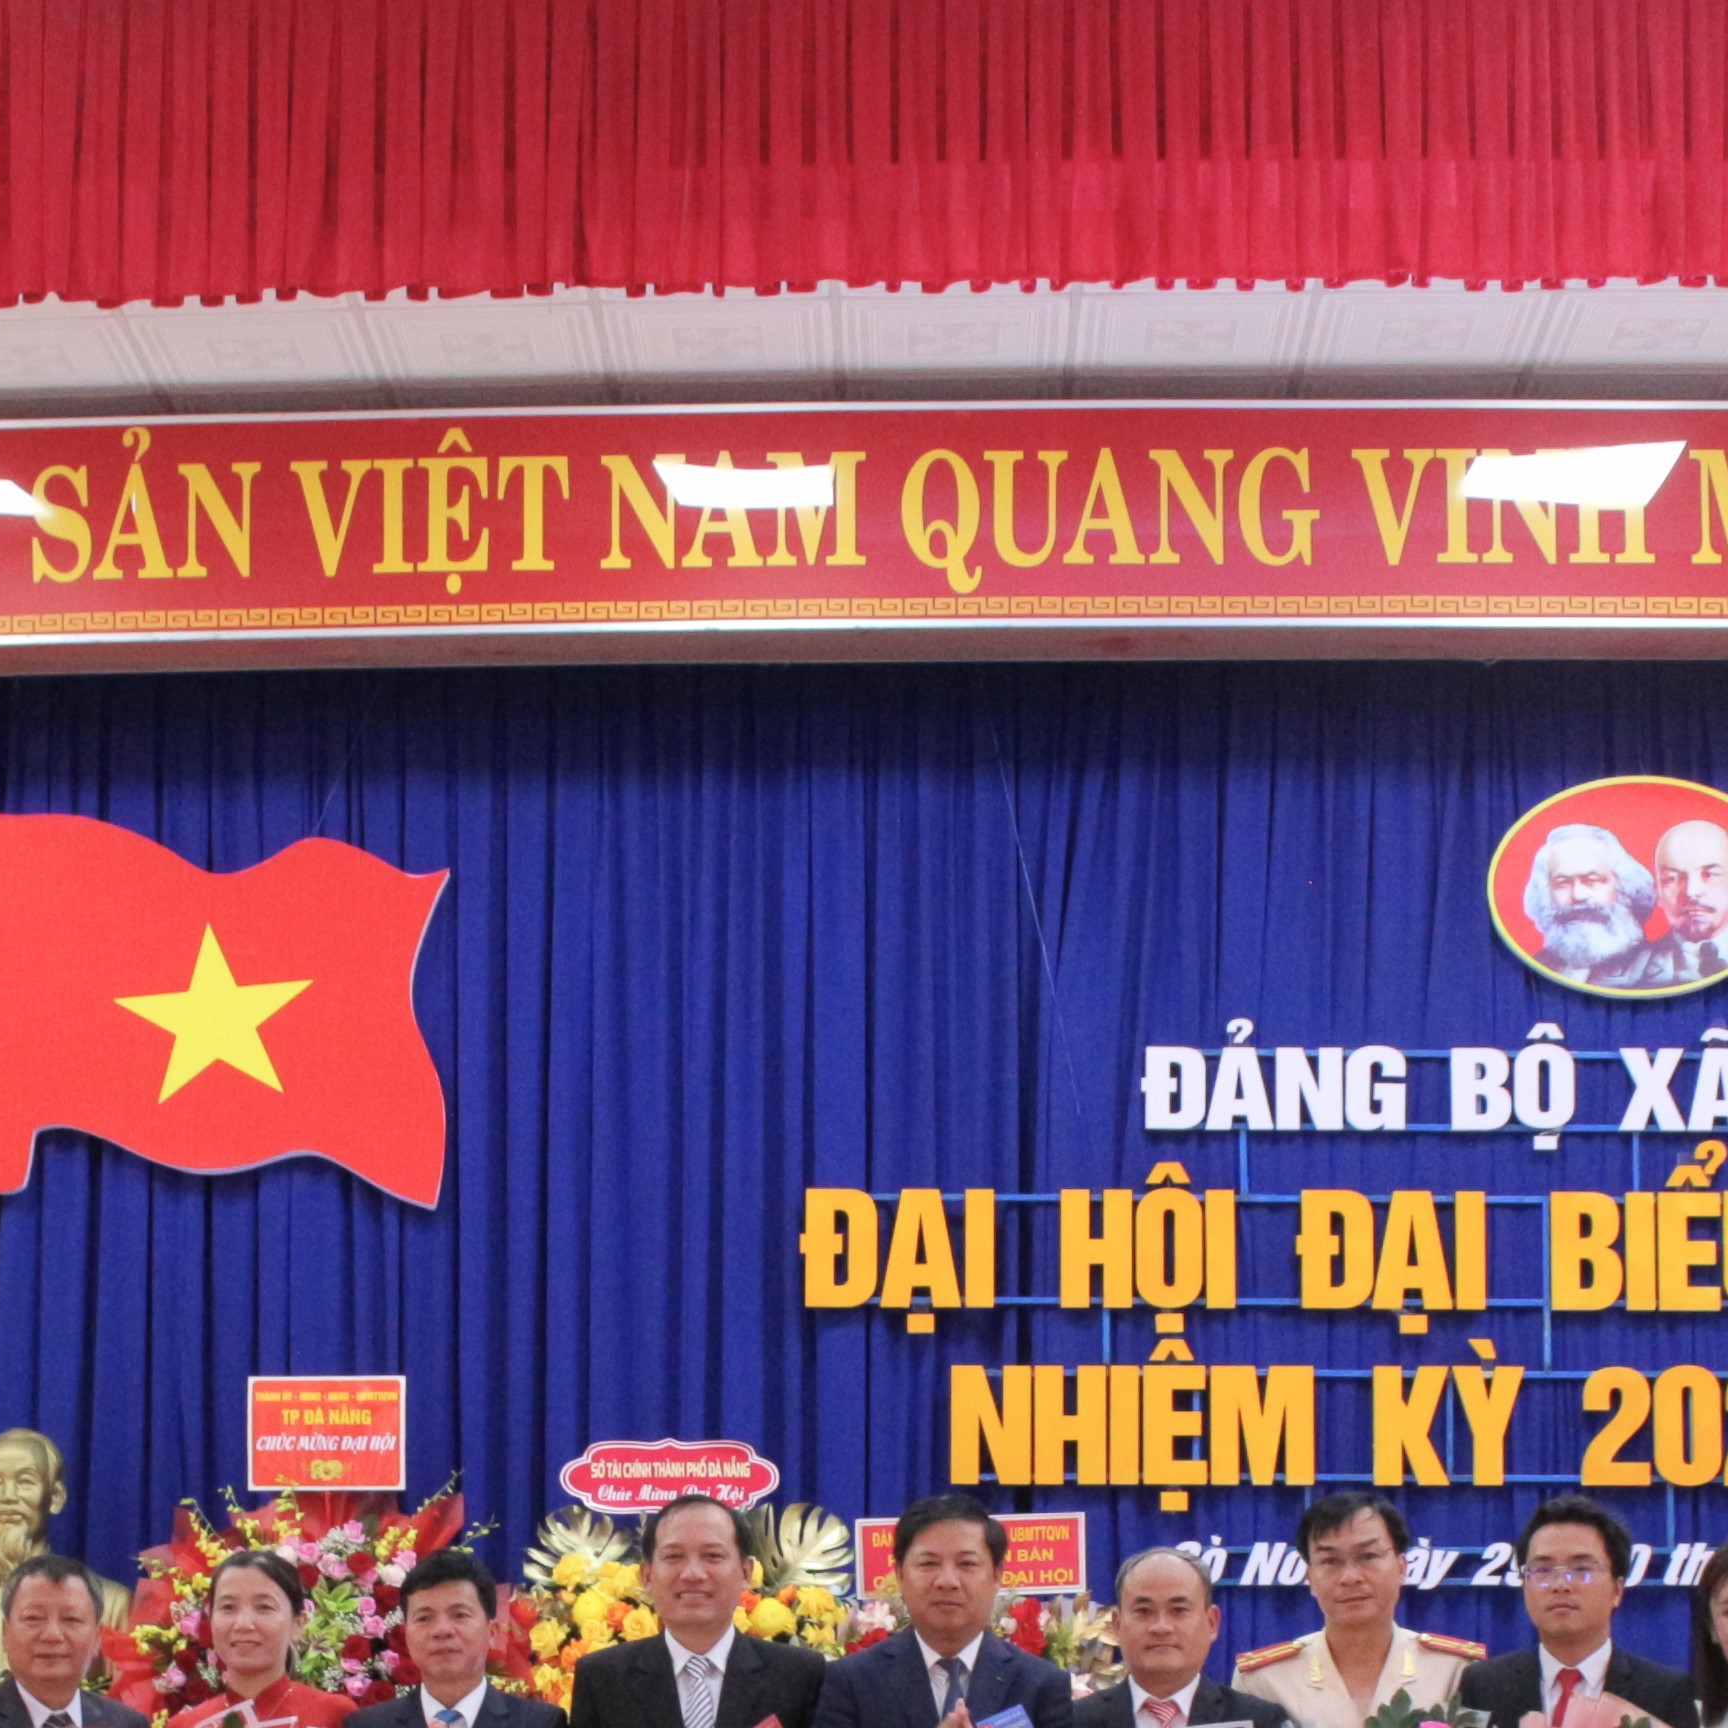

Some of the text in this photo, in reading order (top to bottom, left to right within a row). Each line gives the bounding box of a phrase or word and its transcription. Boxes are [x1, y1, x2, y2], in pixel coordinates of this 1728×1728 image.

[32, 427, 260, 584] SẢN
[305, 427, 571, 593] VIỆT
[600, 450, 867, 569] NAM
[900, 446, 1319, 593] QUANG
[1351, 448, 1656, 565] VINH
[1141, 1018, 1406, 1131] ĐẢNG
[1450, 1022, 1575, 1150] BỘ
[799, 1189, 995, 1333] ĐẠI
[1059, 1162, 1236, 1332] HỘI
[1295, 1190, 1490, 1333] ĐẠI
[256, 1432, 296, 1451] CHÚC
[281, 1409, 300, 1426] TP
[304, 1405, 325, 1426] ĐÀ
[950, 1338, 1315, 1512] NHIỆM
[1372, 1339, 1523, 1487] KỲ
[597, 1484, 633, 1502] Chúc
[653, 1458, 685, 1478] THÀNH
